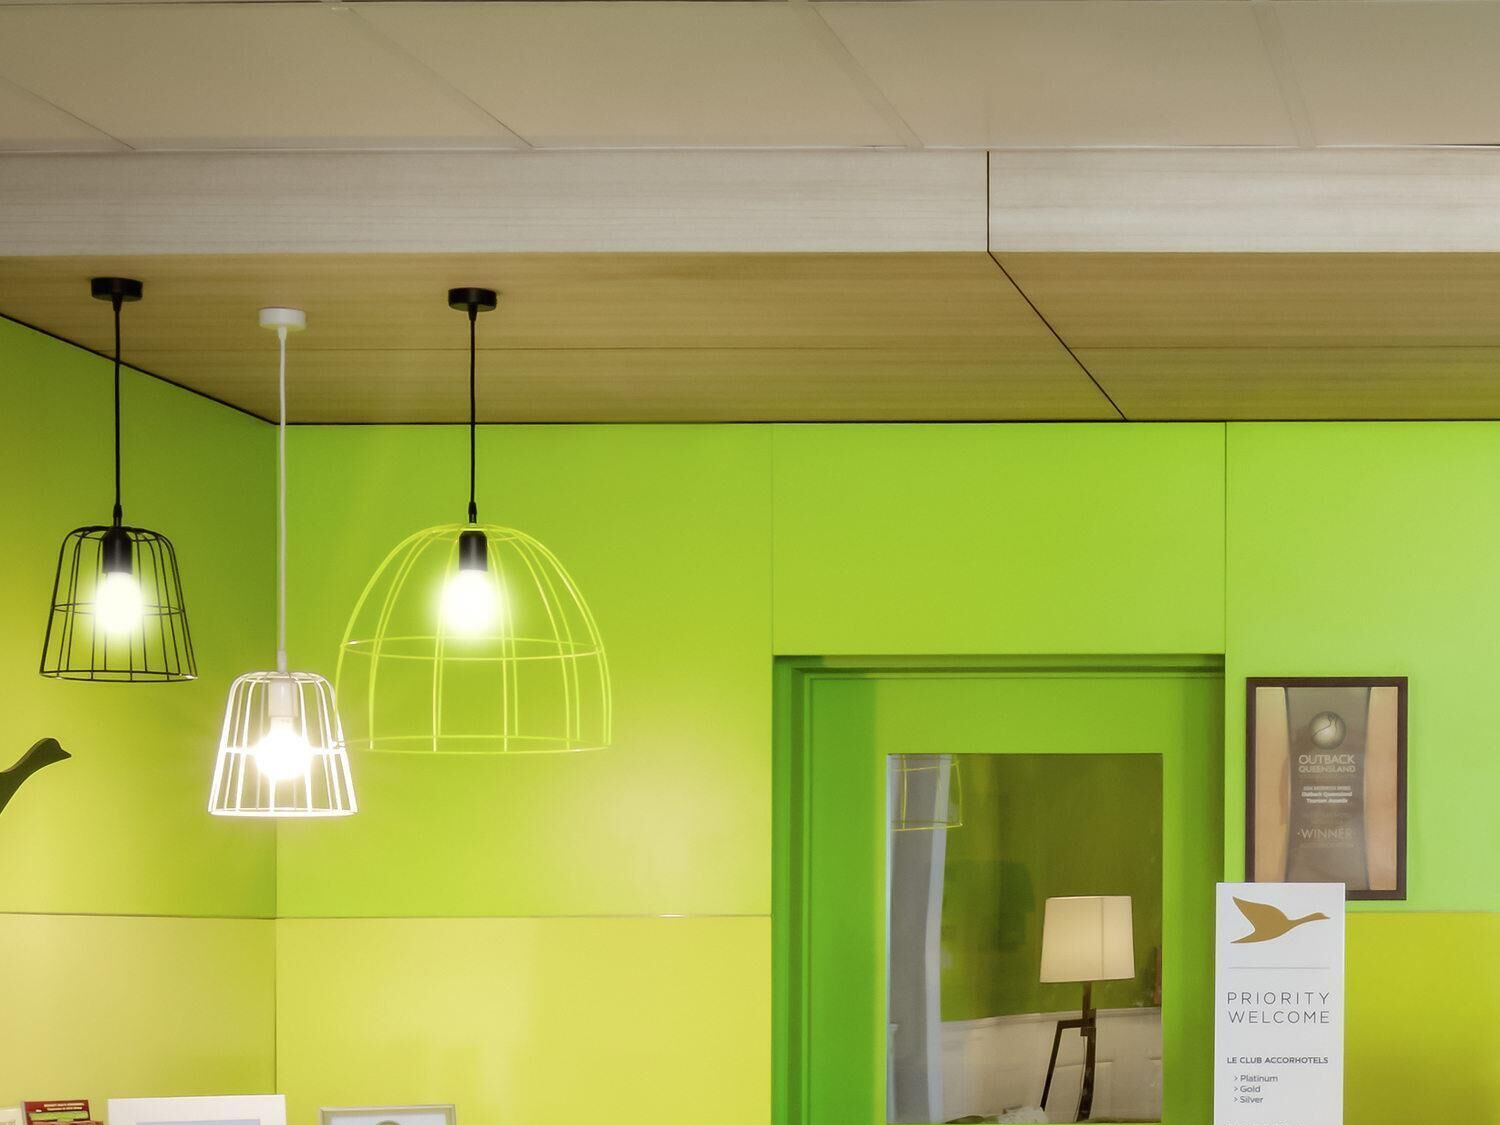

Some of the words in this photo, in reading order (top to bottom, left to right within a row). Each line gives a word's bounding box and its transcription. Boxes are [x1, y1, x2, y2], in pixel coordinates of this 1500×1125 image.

[1298, 754, 1356, 765] OUTBACK
[1298, 765, 1356, 773] QUEENSLAND
[1301, 828, 1353, 840] WINNER
[1227, 991, 1331, 1005] PRIORITY
[1227, 1010, 1331, 1024] WELCOME
[1226, 1056, 1237, 1064] LE
[1239, 1056, 1263, 1064] CLUB
[1264, 1056, 1329, 1064] ACCORHOTELS
[1240, 1074, 1279, 1082] Platinum
[1240, 1085, 1261, 1093] Gold
[1240, 1095, 1264, 1104] Silver
